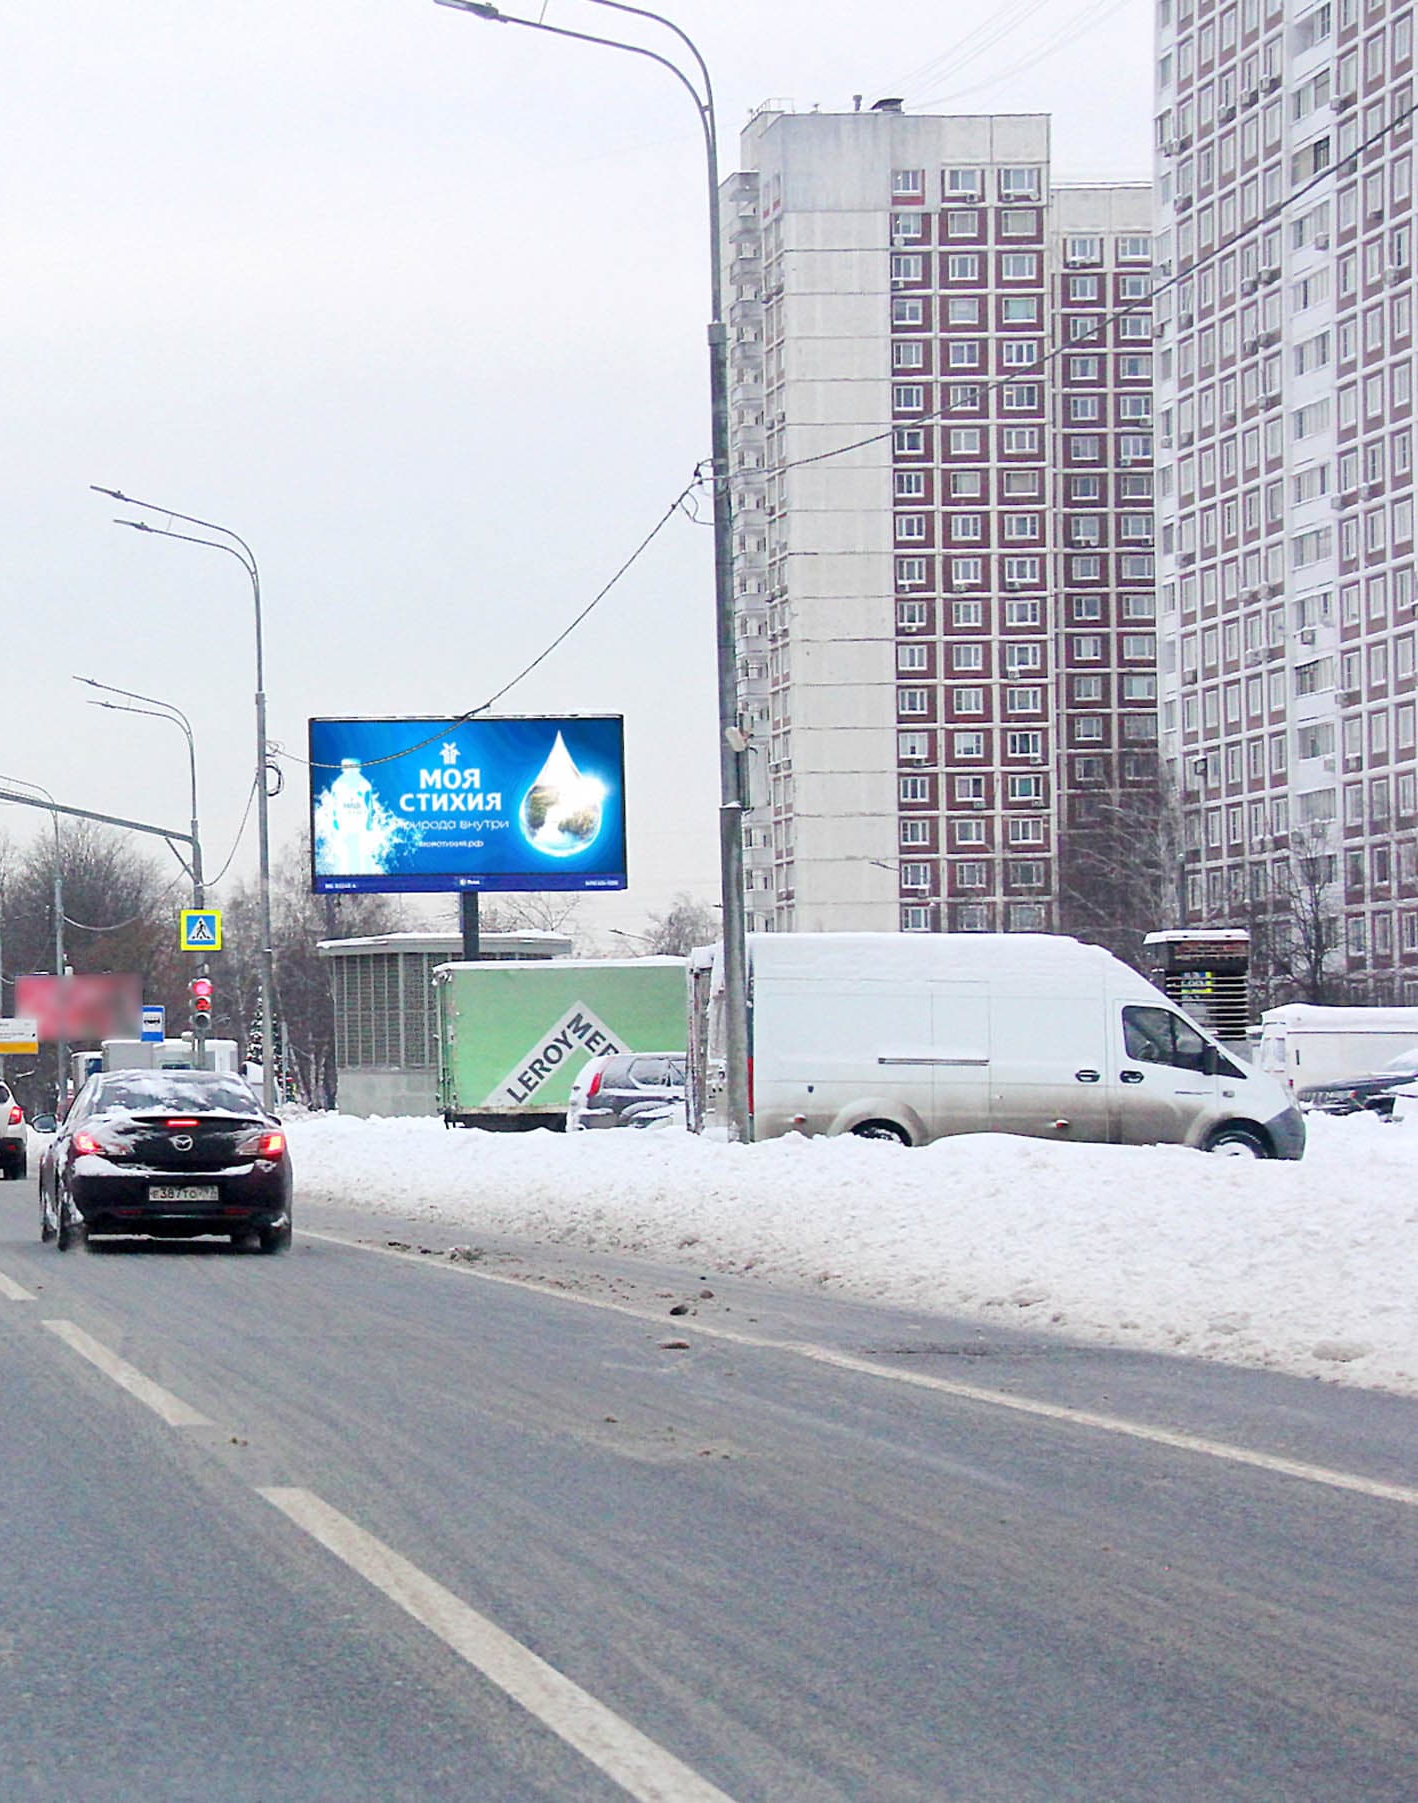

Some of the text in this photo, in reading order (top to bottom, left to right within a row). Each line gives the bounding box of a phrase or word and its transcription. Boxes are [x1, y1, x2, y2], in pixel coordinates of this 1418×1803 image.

[420, 769, 480, 789] МОЯ
[399, 792, 502, 812] СТИХИЯ
[459, 819, 510, 831] внутри
[506, 1030, 574, 1104] LEROY
